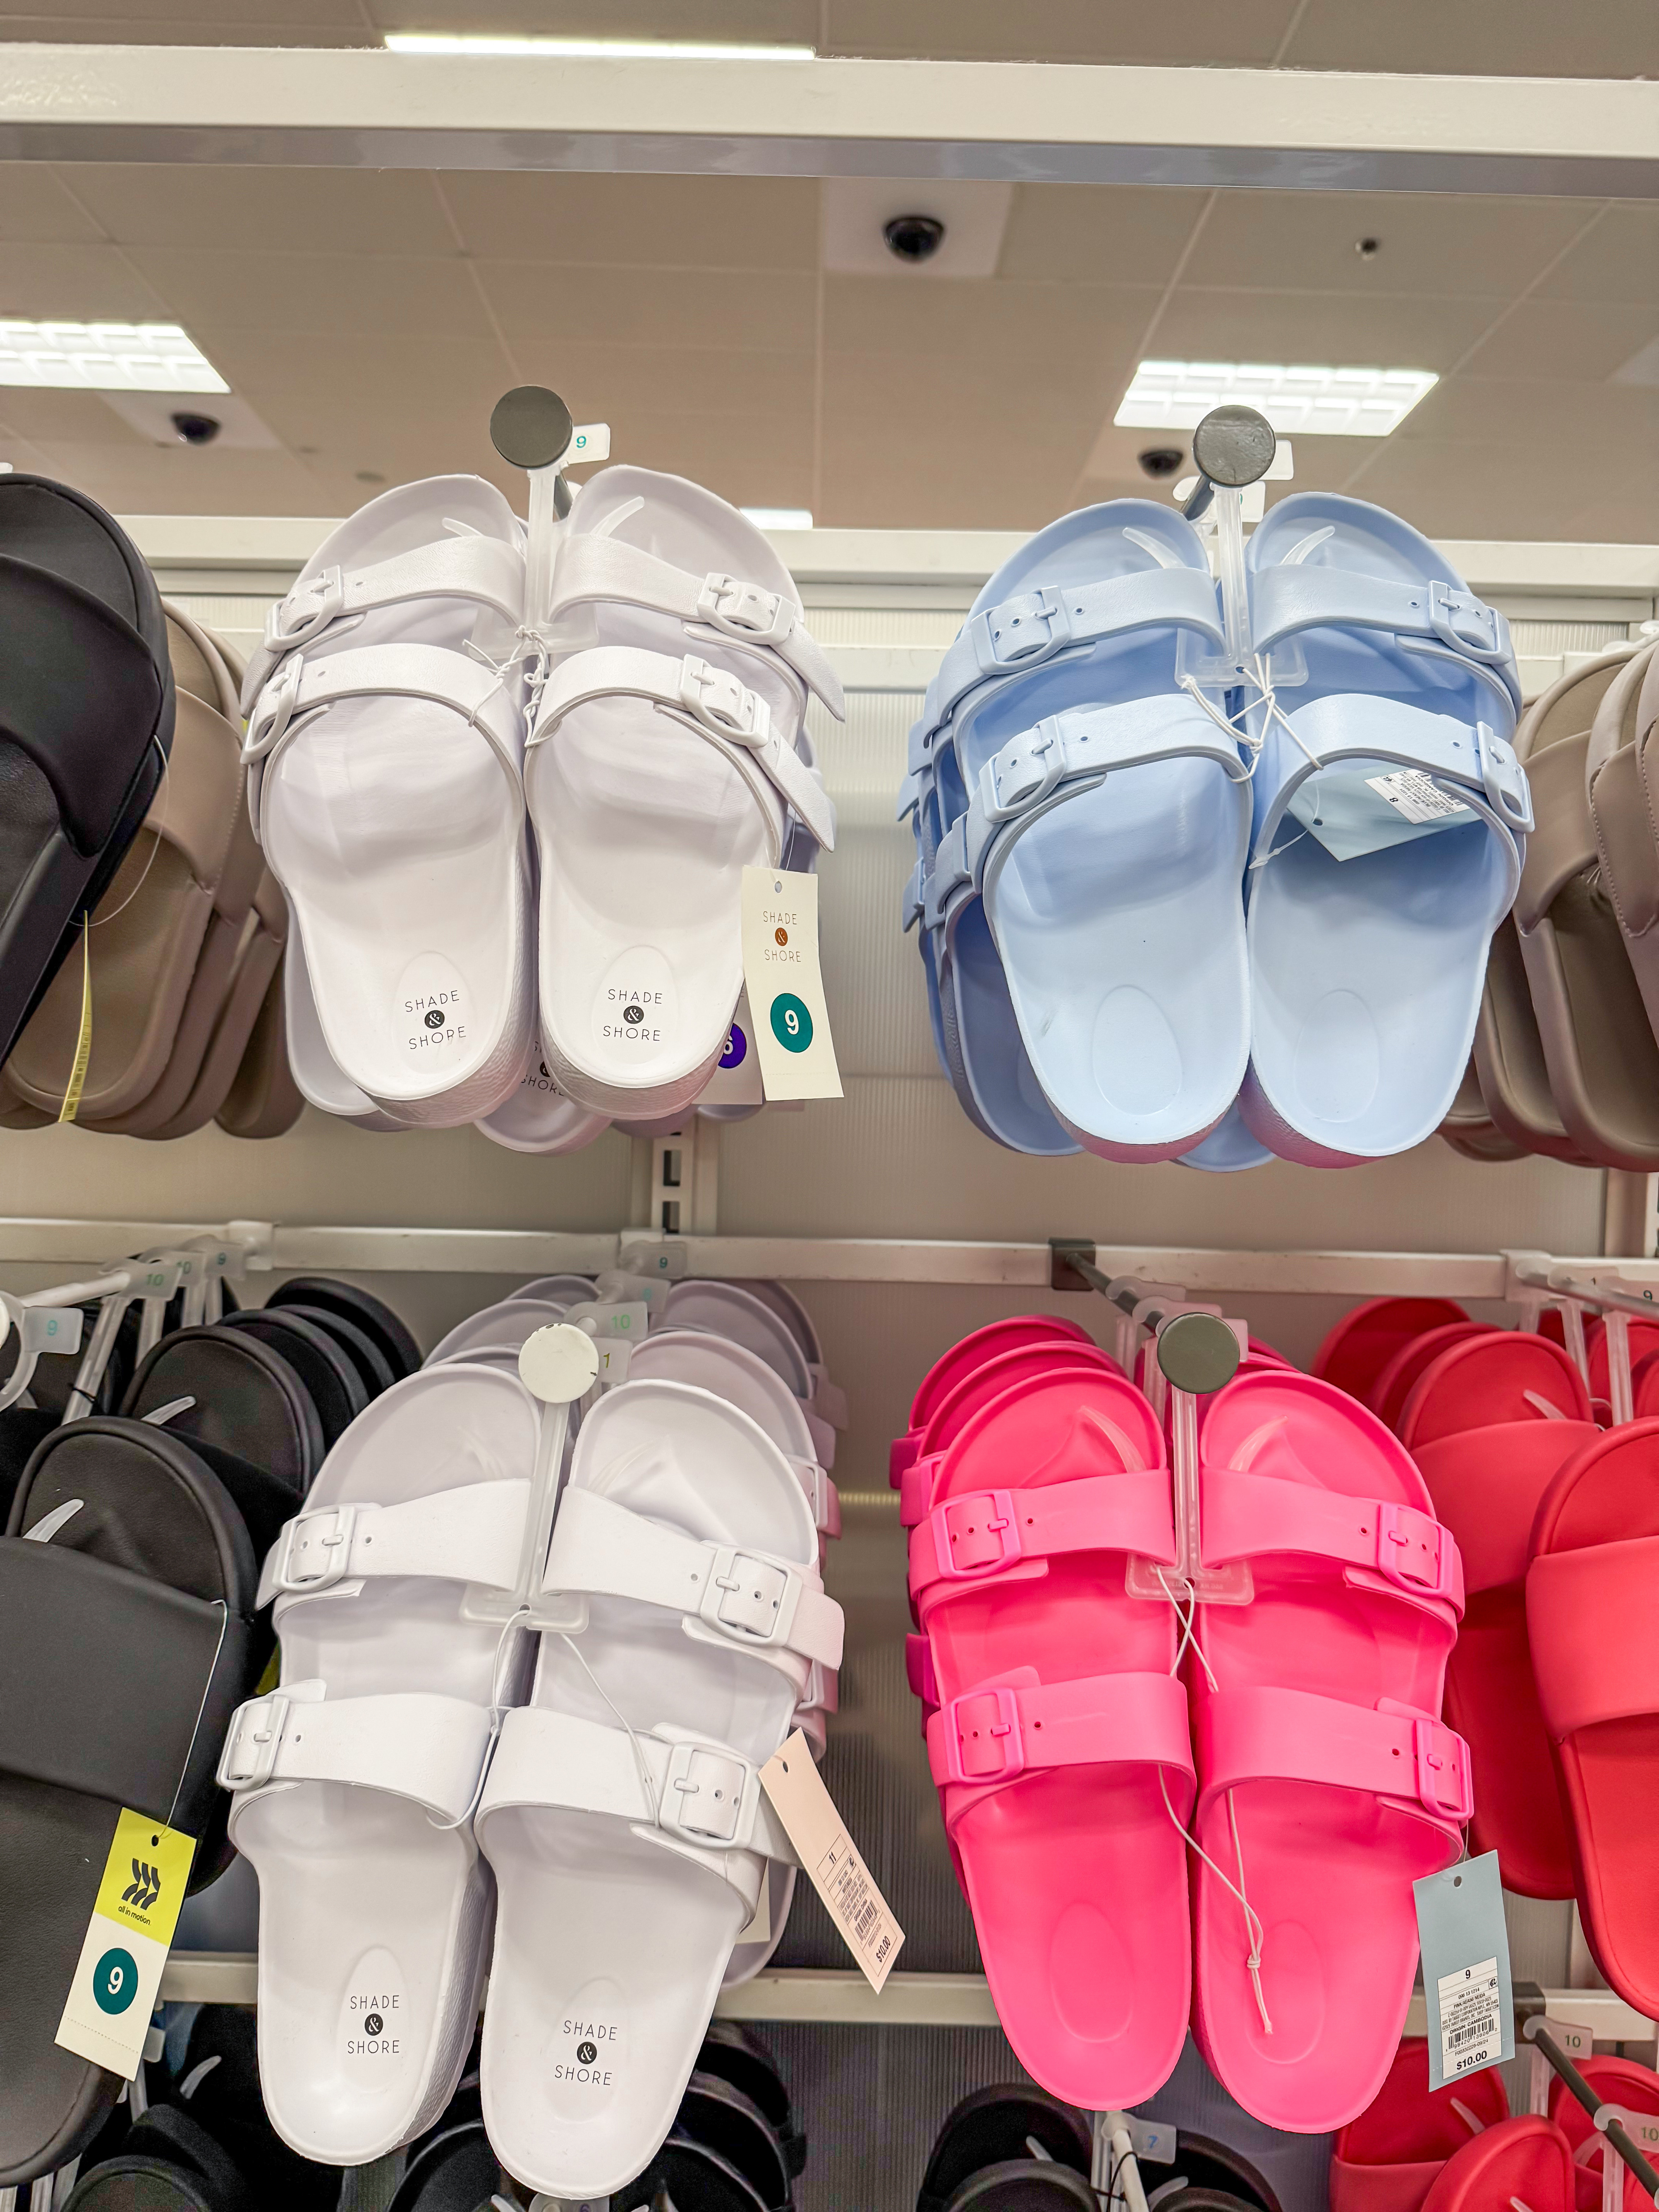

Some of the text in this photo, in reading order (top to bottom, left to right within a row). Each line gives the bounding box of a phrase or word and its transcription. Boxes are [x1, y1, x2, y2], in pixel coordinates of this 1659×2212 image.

[576, 436, 586, 448] 9
[763, 911, 797, 924] SHADE
[764, 949, 801, 962] SHORE
[405, 990, 460, 1012] SHADE
[608, 989, 663, 1004] SHADE
[784, 1009, 799, 1035] 9
[603, 1025, 661, 1041] SHORE
[659, 1257, 668, 1268] 9
[46, 1320, 58, 1336] 9
[611, 1314, 630, 1329] 10
[829, 1851, 836, 1864] 11
[125, 1907, 131, 1916] in
[876, 1936, 891, 1963] $10.00
[107, 1966, 124, 1994] 9
[1466, 1969, 1470, 1979] 9
[350, 1995, 399, 2009] SHADE
[1468, 2013, 1491, 2027] CAMBODIA
[563, 2020, 617, 2040] SHADE
[348, 2040, 399, 2054] SHORE
[1565, 2035, 1581, 2048] 10
[1456, 2050, 1487, 2070] $10.00
[555, 2065, 612, 2085] SHORE
[1641, 2126, 1659, 2141] 10
[1147, 2135, 1158, 2149] 7
